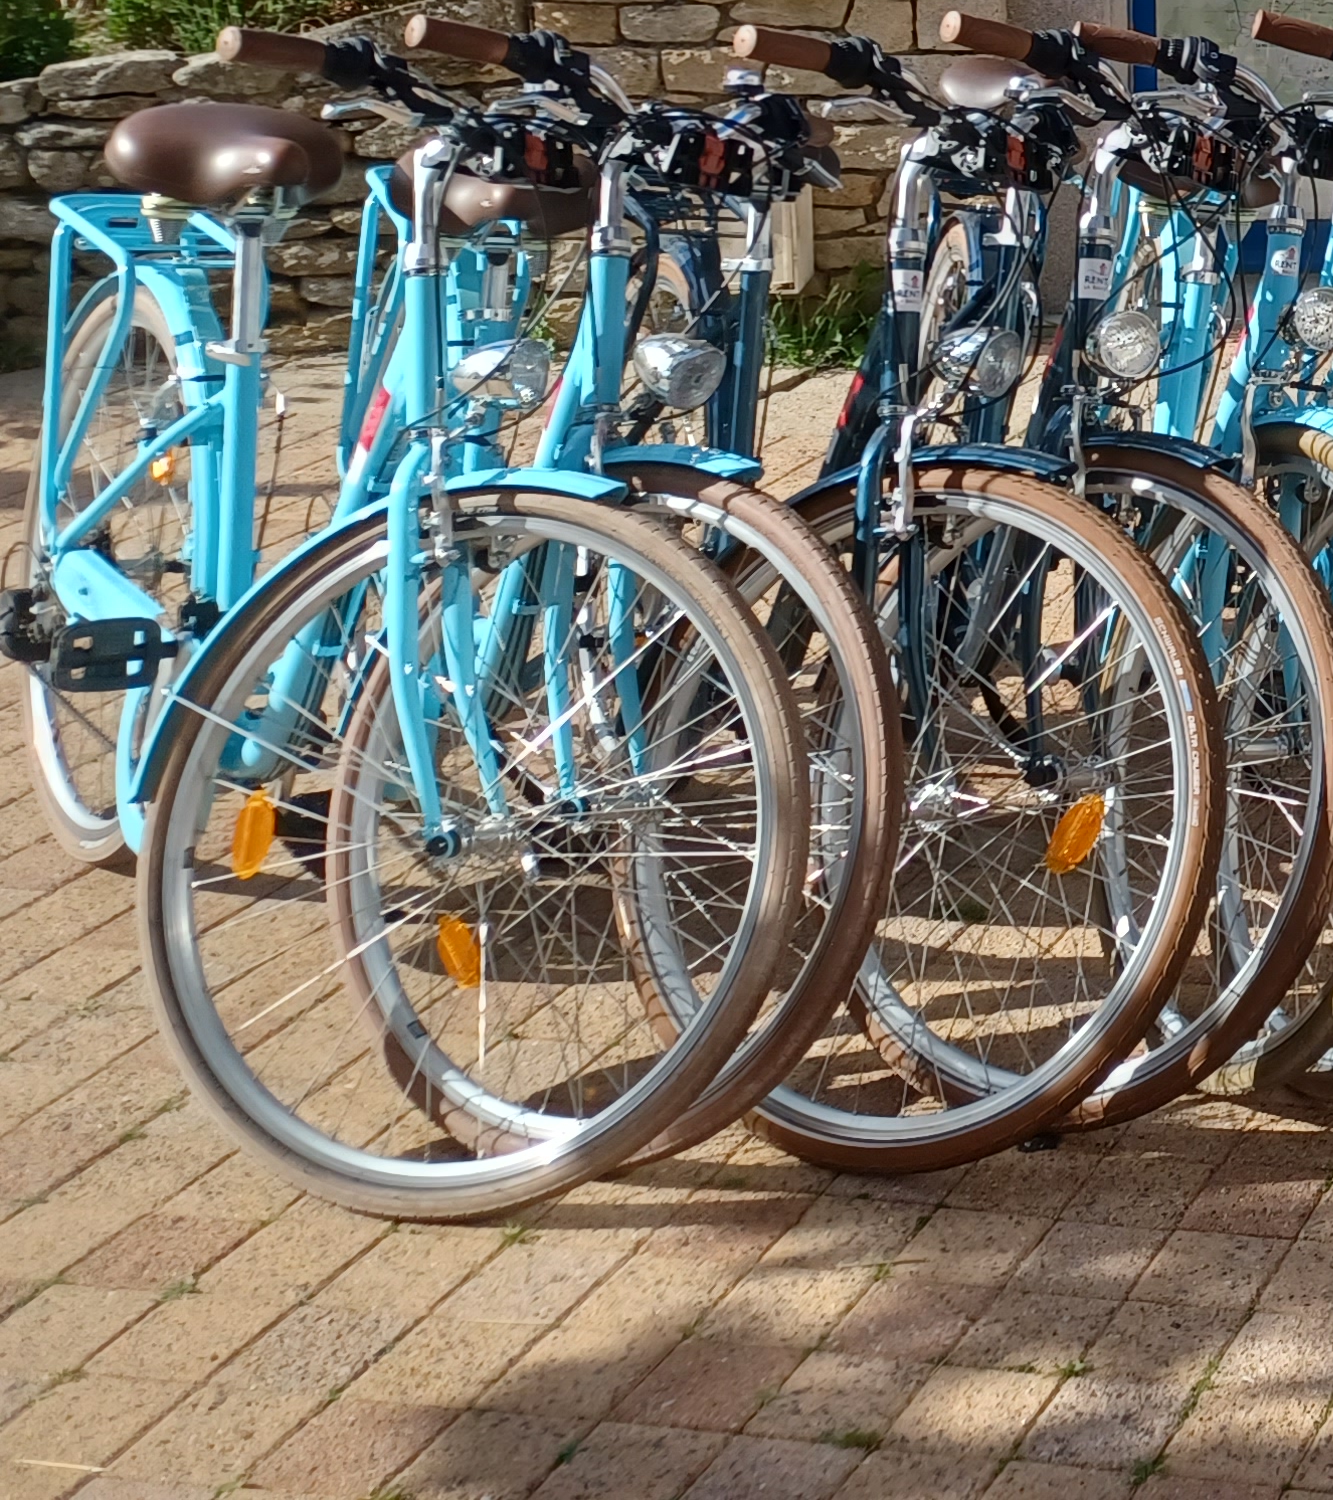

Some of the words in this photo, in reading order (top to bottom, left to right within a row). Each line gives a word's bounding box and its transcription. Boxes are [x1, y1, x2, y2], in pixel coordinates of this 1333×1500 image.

[1084, 275, 1108, 285] RENT
[1275, 259, 1297, 270] RENT
[1153, 616, 1183, 675] SCHWALBE
[1187, 715, 1199, 748] DELTA
[1191, 751, 1201, 795] CRUISER
